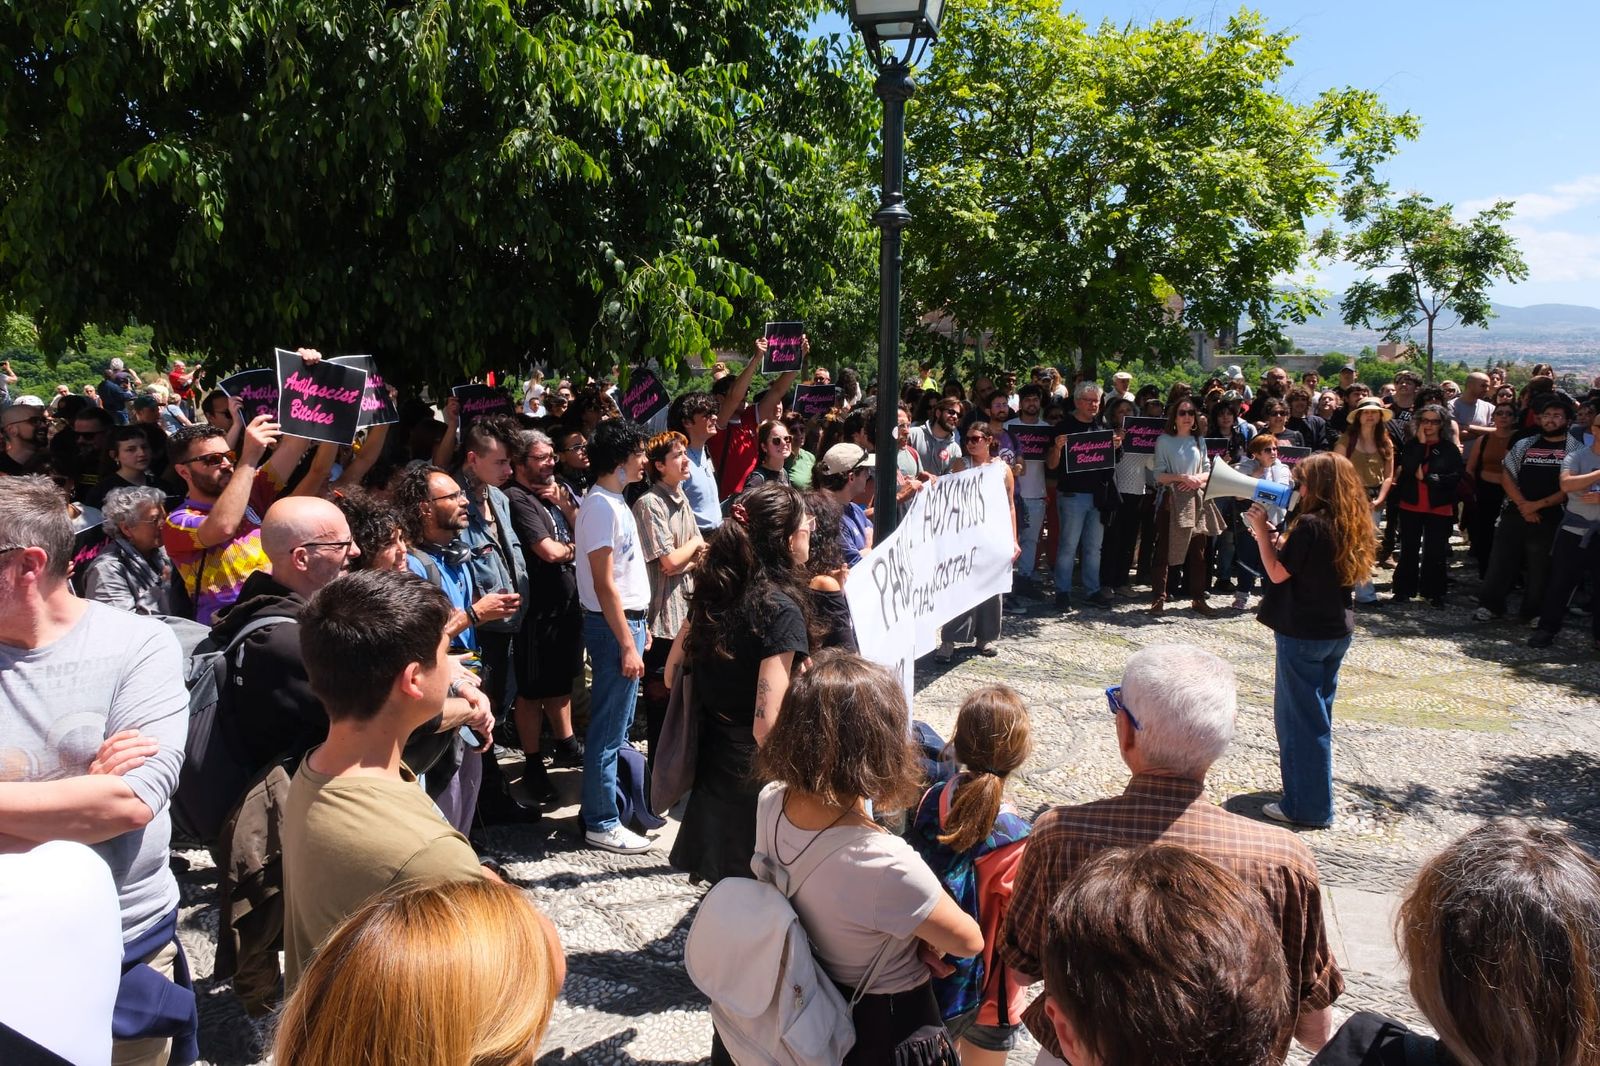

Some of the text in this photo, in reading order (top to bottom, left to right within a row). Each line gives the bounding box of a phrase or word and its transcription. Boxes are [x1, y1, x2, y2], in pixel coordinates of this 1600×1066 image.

[239, 384, 278, 404] Antifa
[284, 371, 359, 404] Antifascist
[290, 399, 334, 425] Bitches
[1069, 440, 1112, 453] Antifascist
[1076, 453, 1104, 464] Bitches
